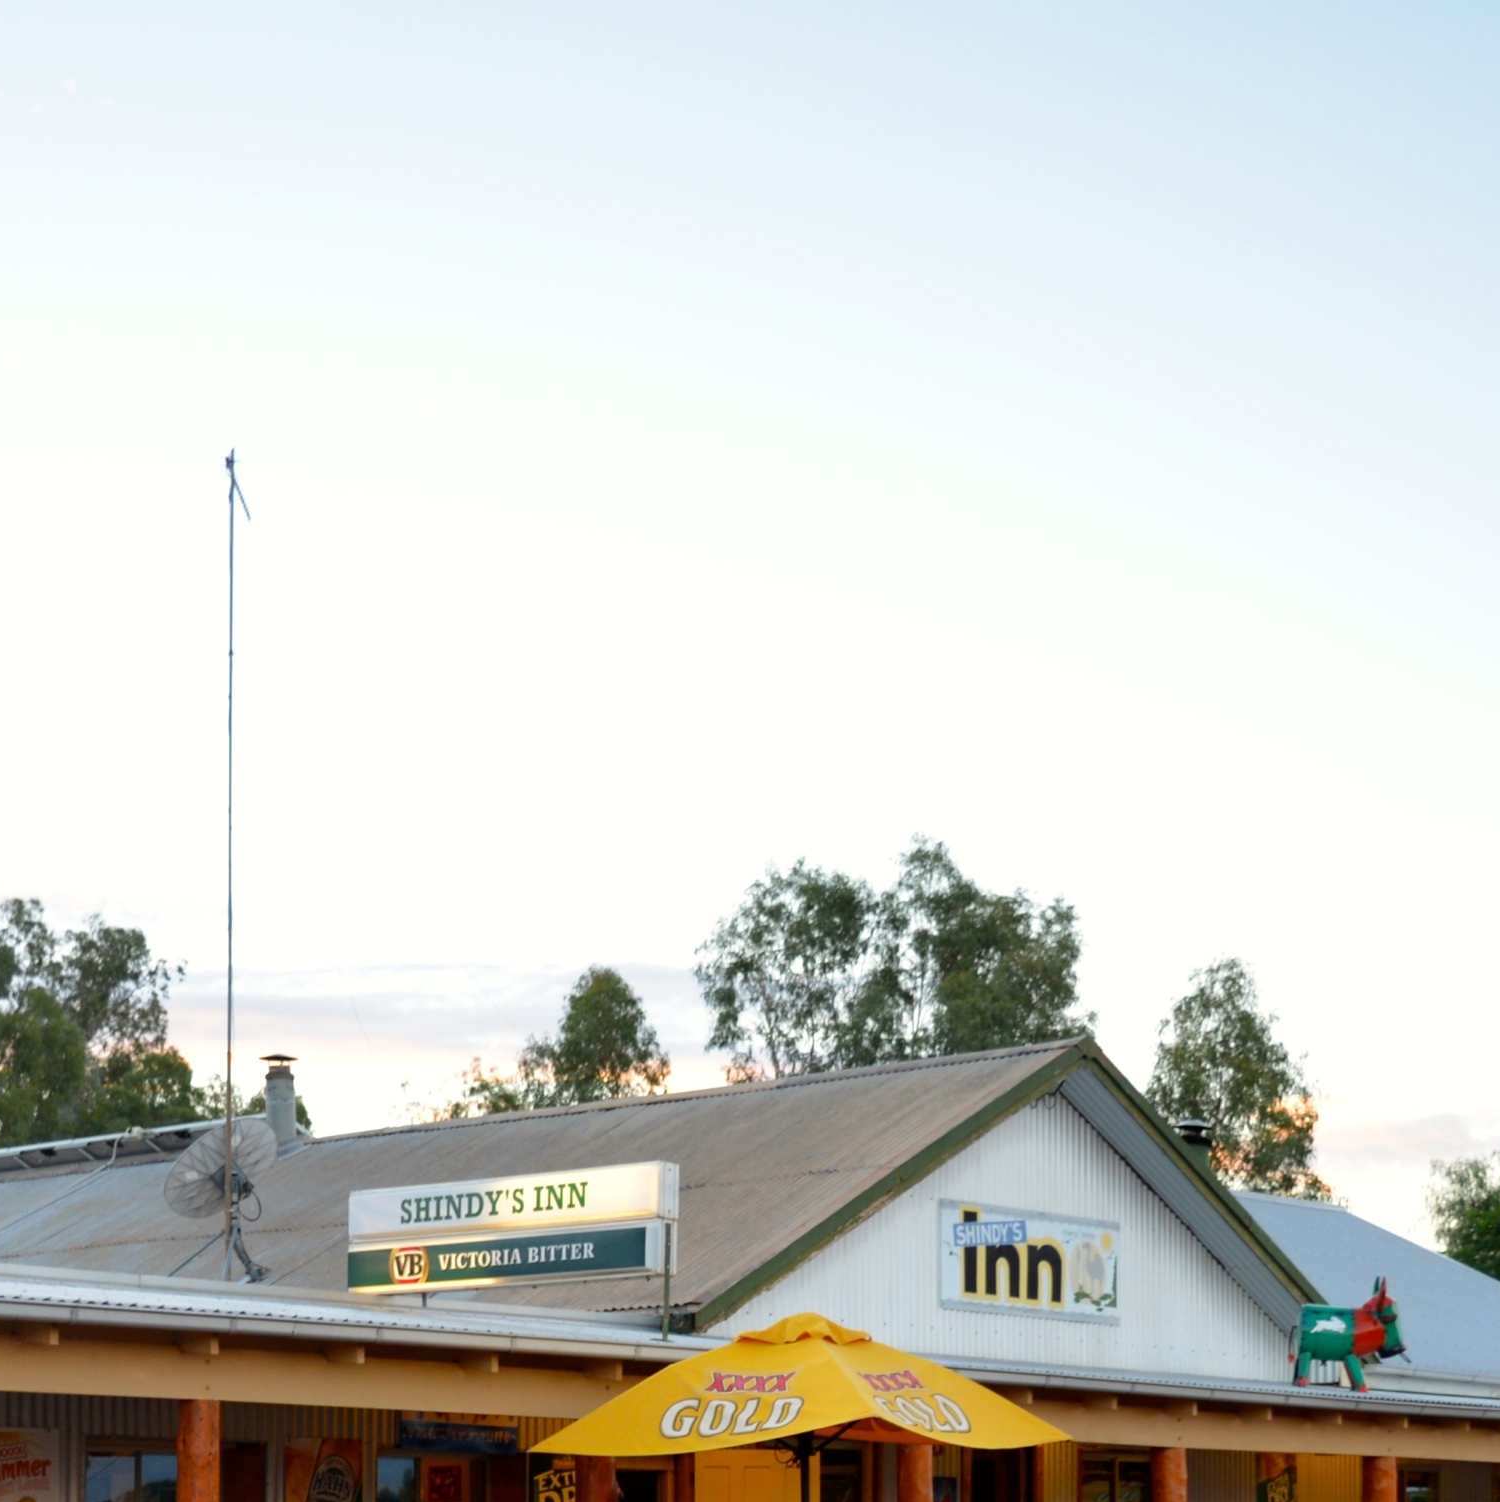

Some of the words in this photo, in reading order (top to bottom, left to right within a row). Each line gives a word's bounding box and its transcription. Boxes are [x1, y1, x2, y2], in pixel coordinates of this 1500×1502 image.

[401, 1186, 525, 1224] SHINDY'S
[533, 1181, 589, 1212] INN
[955, 1222, 1023, 1245] SHINDY'S
[393, 1252, 425, 1278] VB
[438, 1247, 522, 1271] VICTORIA
[527, 1241, 595, 1264] BITTER
[704, 1371, 797, 1393] XXXX
[659, 1396, 805, 1440] GOLD
[873, 1393, 972, 1434] GOLD
[313, 1471, 351, 1499] HAHN
[534, 1469, 576, 1492] EXT
